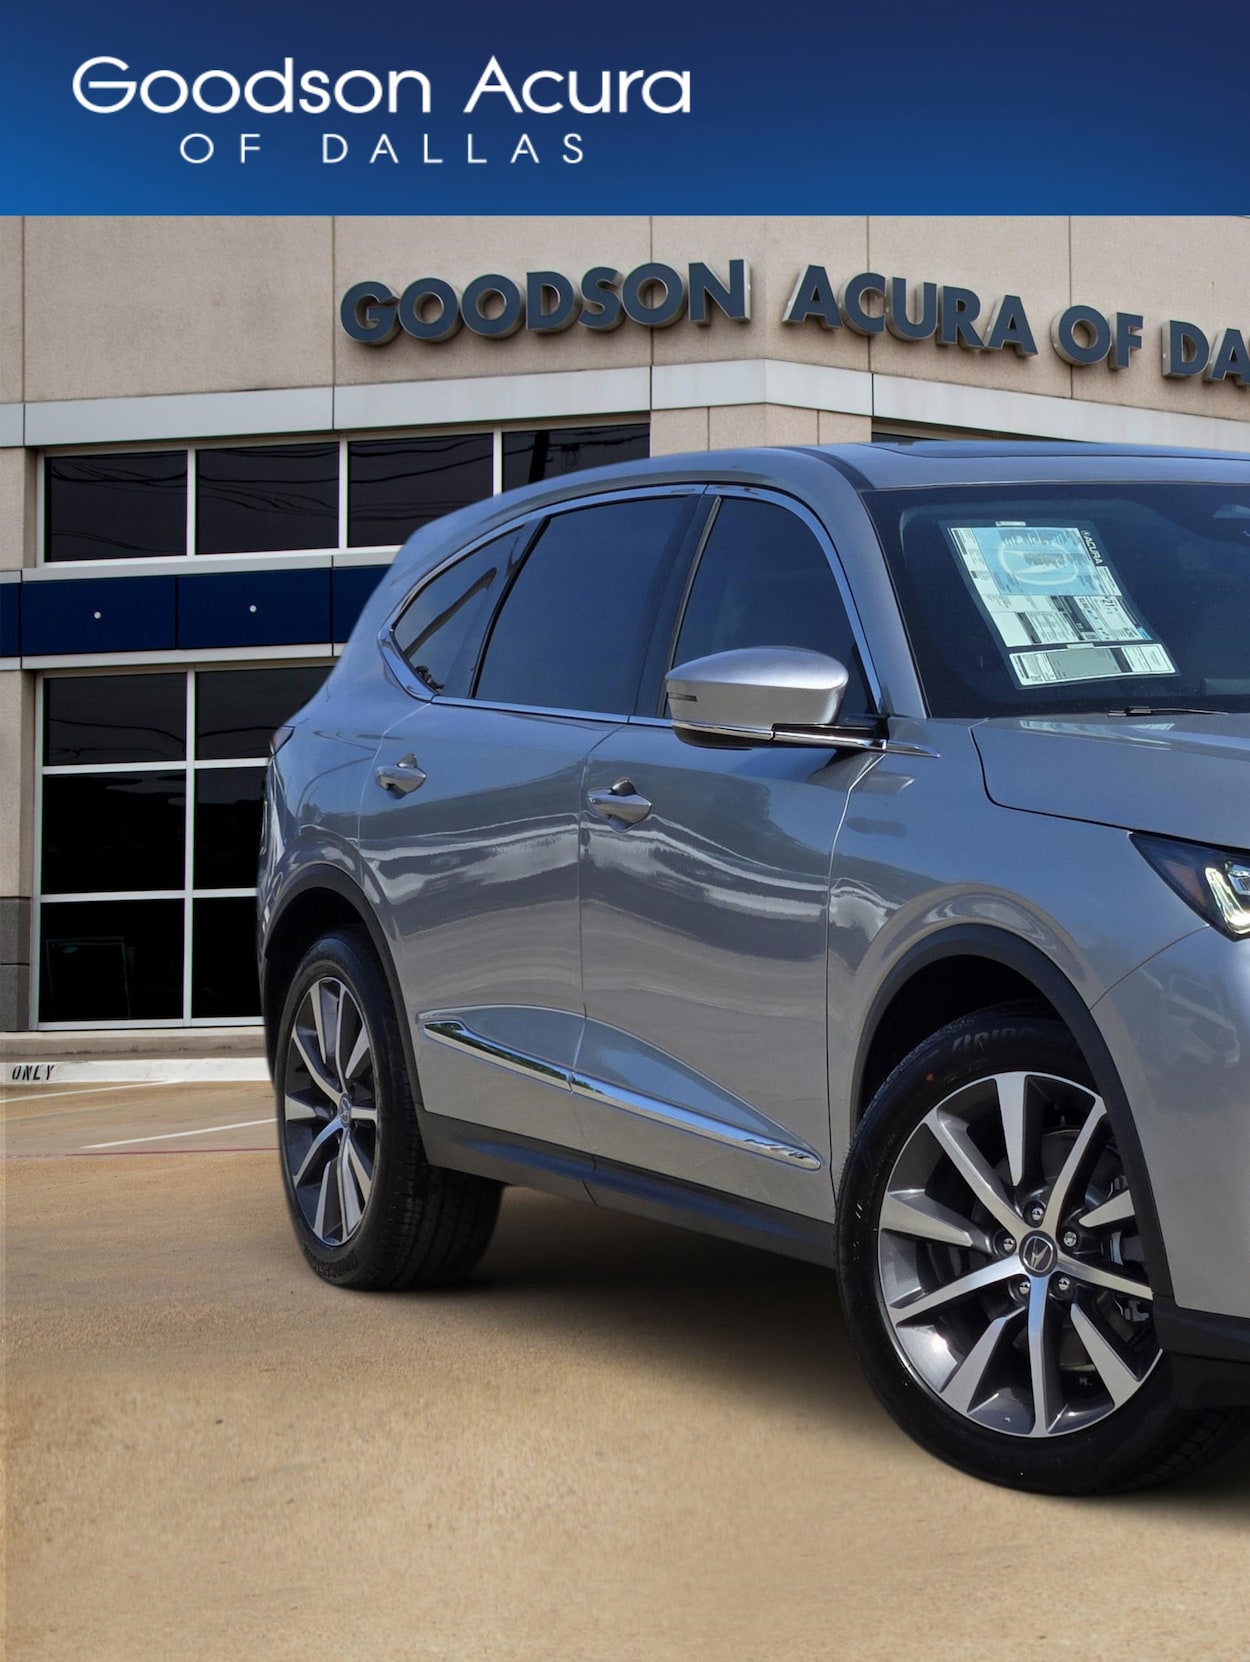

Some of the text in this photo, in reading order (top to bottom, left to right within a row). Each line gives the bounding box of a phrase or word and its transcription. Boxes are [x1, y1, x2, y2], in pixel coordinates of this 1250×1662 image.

[340, 259, 750, 346] GOODSON
[783, 264, 1039, 357] ACURA
[1050, 304, 1144, 370] OF
[1083, 535, 1103, 565] ACURA
[11, 1064, 55, 1081] ONLY
